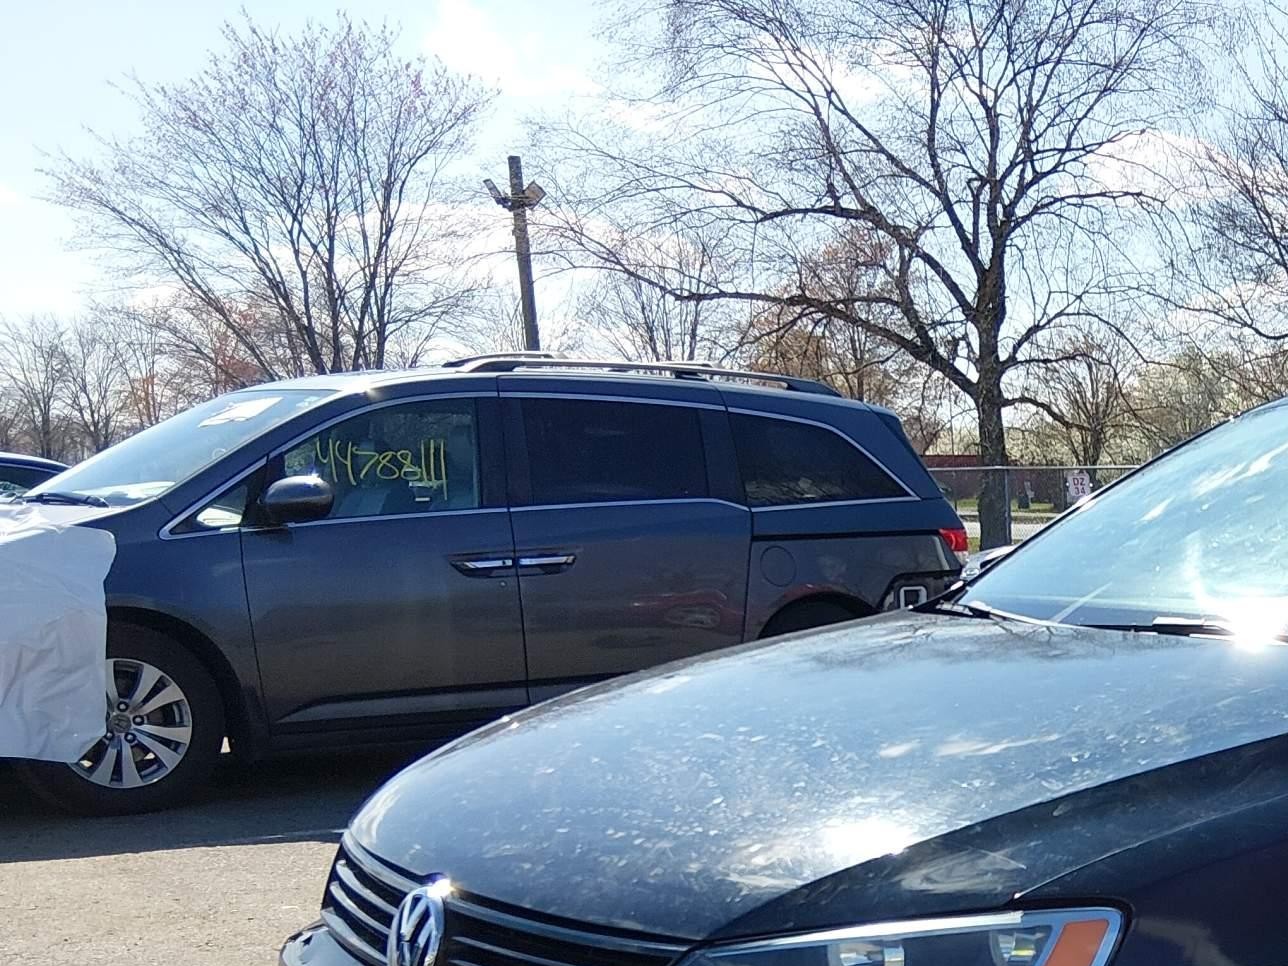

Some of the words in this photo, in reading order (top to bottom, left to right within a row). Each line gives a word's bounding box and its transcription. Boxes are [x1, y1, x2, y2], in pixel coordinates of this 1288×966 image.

[316, 437, 448, 500] 44788111
[1072, 477, 1086, 486] DZ
[1074, 486, 1086, 495] 34
